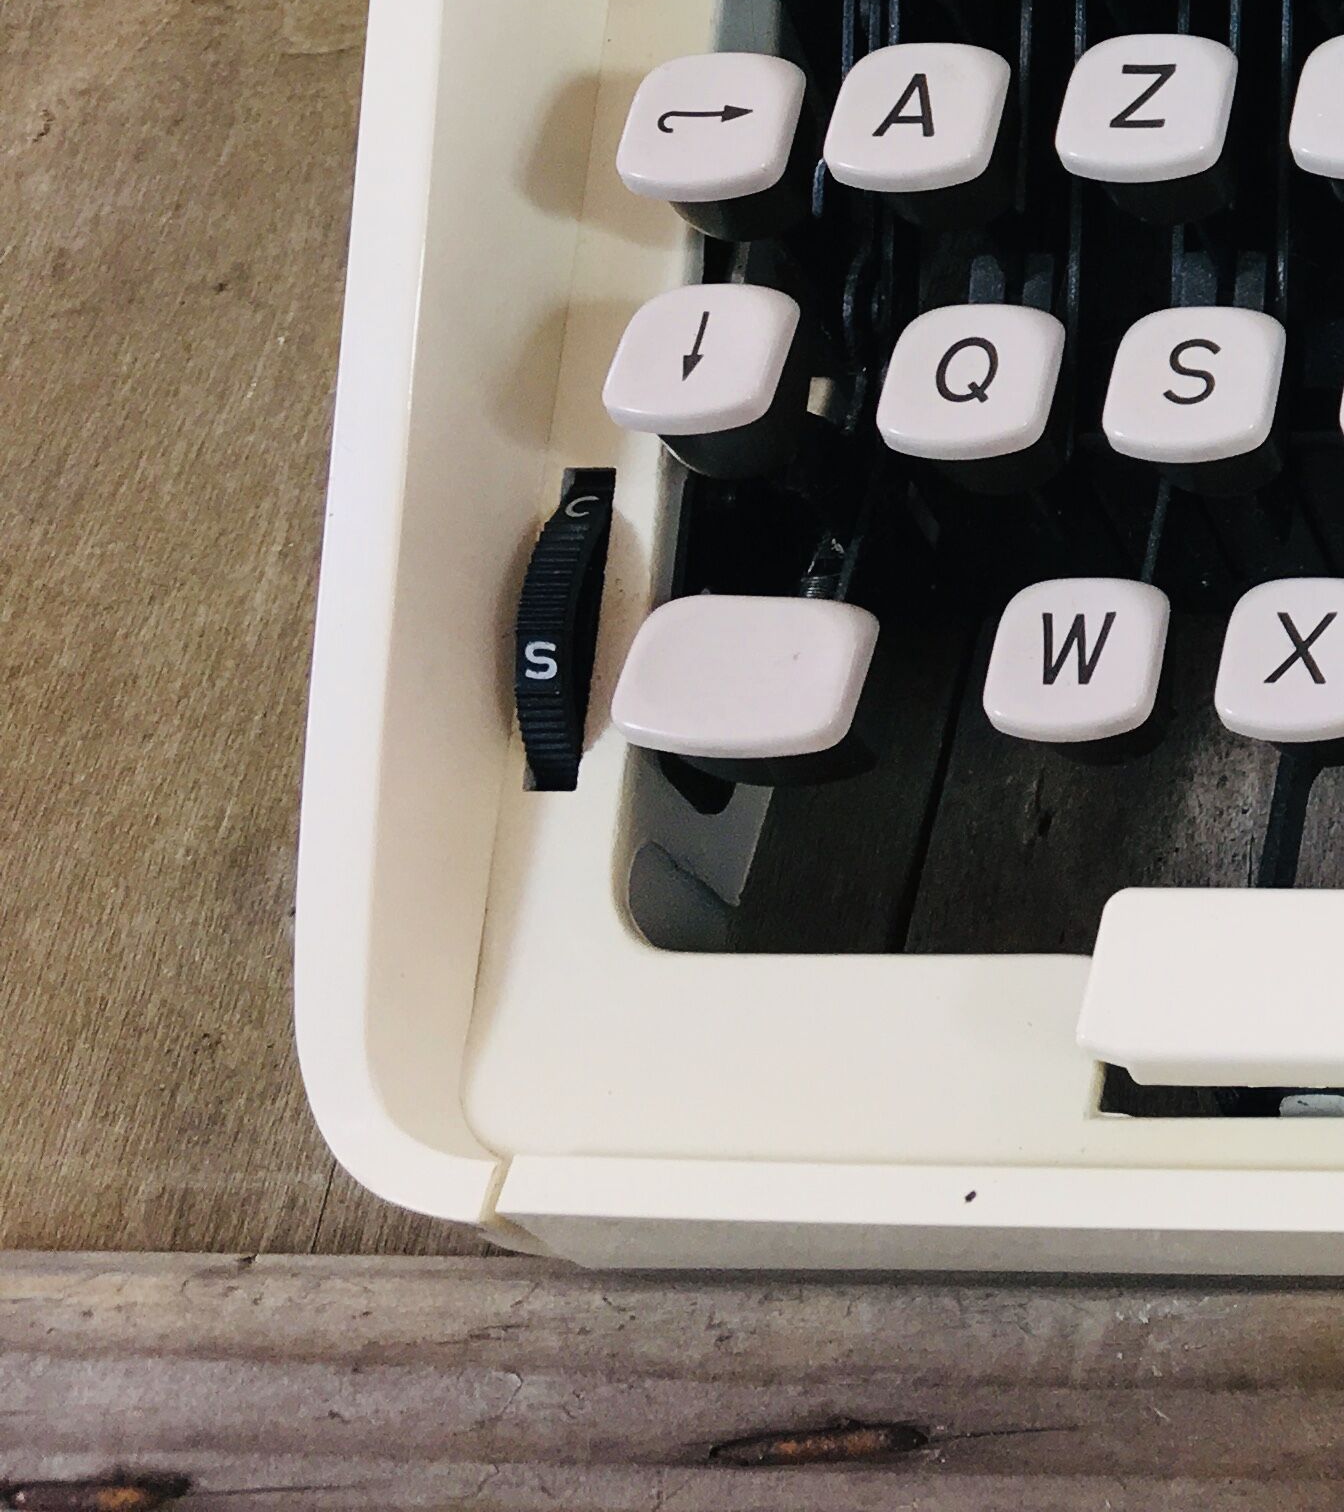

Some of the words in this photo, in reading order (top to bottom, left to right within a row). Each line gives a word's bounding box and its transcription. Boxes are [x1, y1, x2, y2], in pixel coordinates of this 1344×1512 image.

[870, 71, 936, 139] A
[1108, 62, 1178, 130] Z
[934, 335, 1000, 405] Q
[1161, 337, 1223, 407] S
[523, 640, 559, 681] S
[1040, 610, 1118, 687] W
[1262, 610, 1339, 686] X
